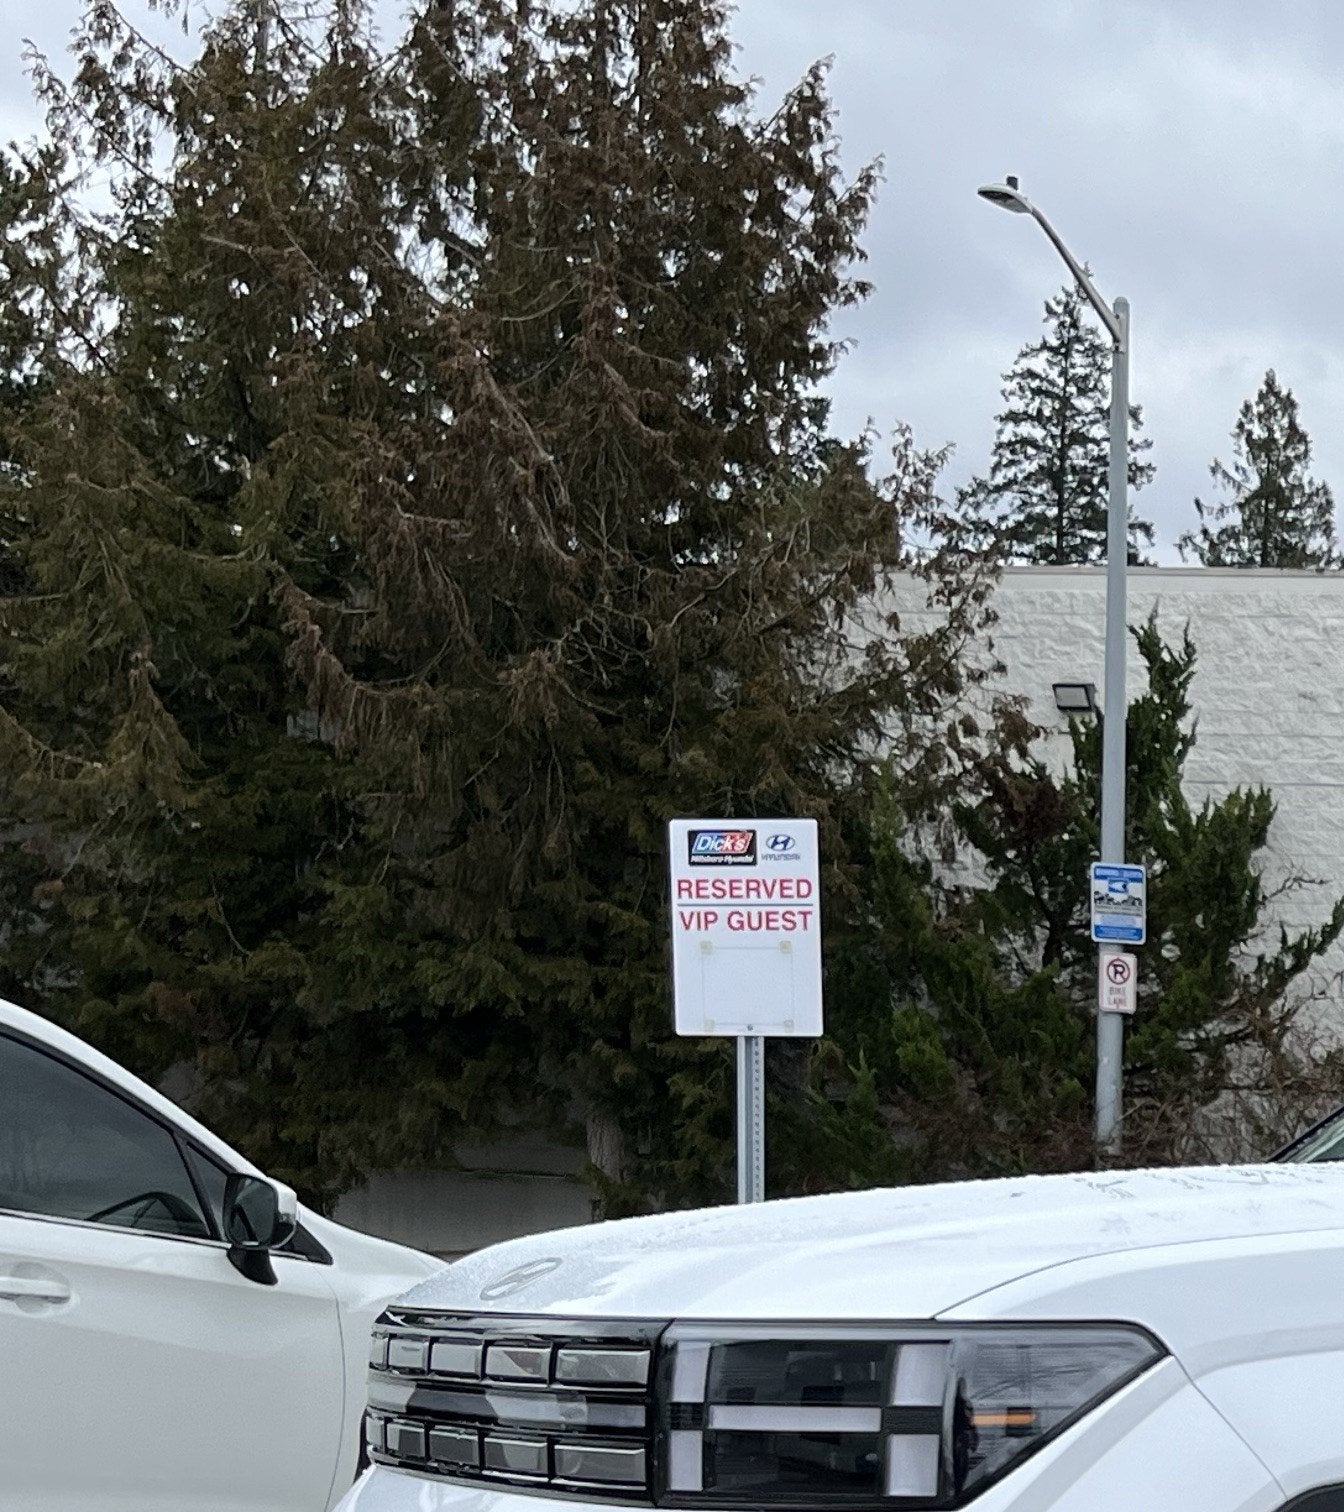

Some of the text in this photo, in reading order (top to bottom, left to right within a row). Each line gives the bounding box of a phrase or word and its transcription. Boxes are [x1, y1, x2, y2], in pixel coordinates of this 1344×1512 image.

[677, 878, 813, 899] RESERVED
[679, 910, 813, 931] VIP GUEST
